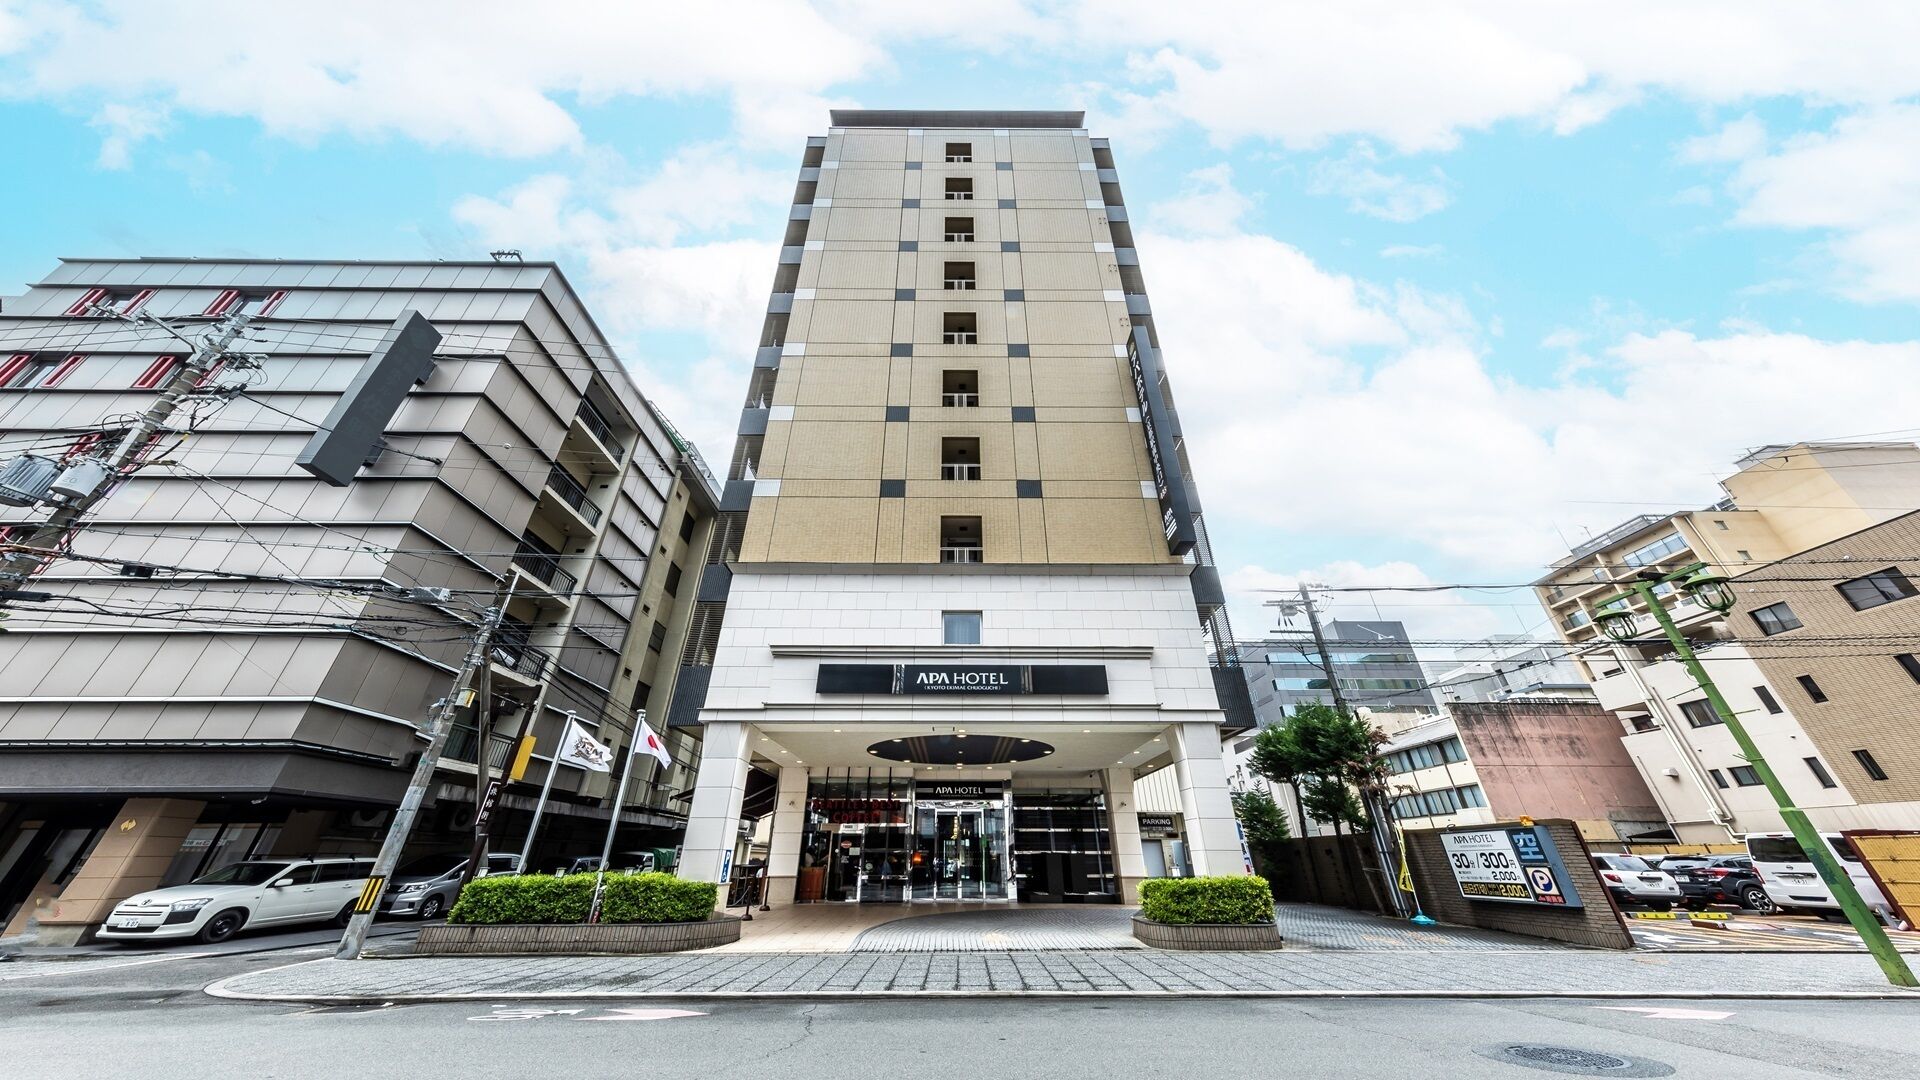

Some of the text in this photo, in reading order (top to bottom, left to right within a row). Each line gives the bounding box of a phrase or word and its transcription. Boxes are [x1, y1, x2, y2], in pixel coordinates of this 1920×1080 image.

[916, 671, 1009, 685] APA HOTEL
[935, 786, 983, 794] APA HOTEL
[1453, 834, 1496, 844] APA HOTEL
